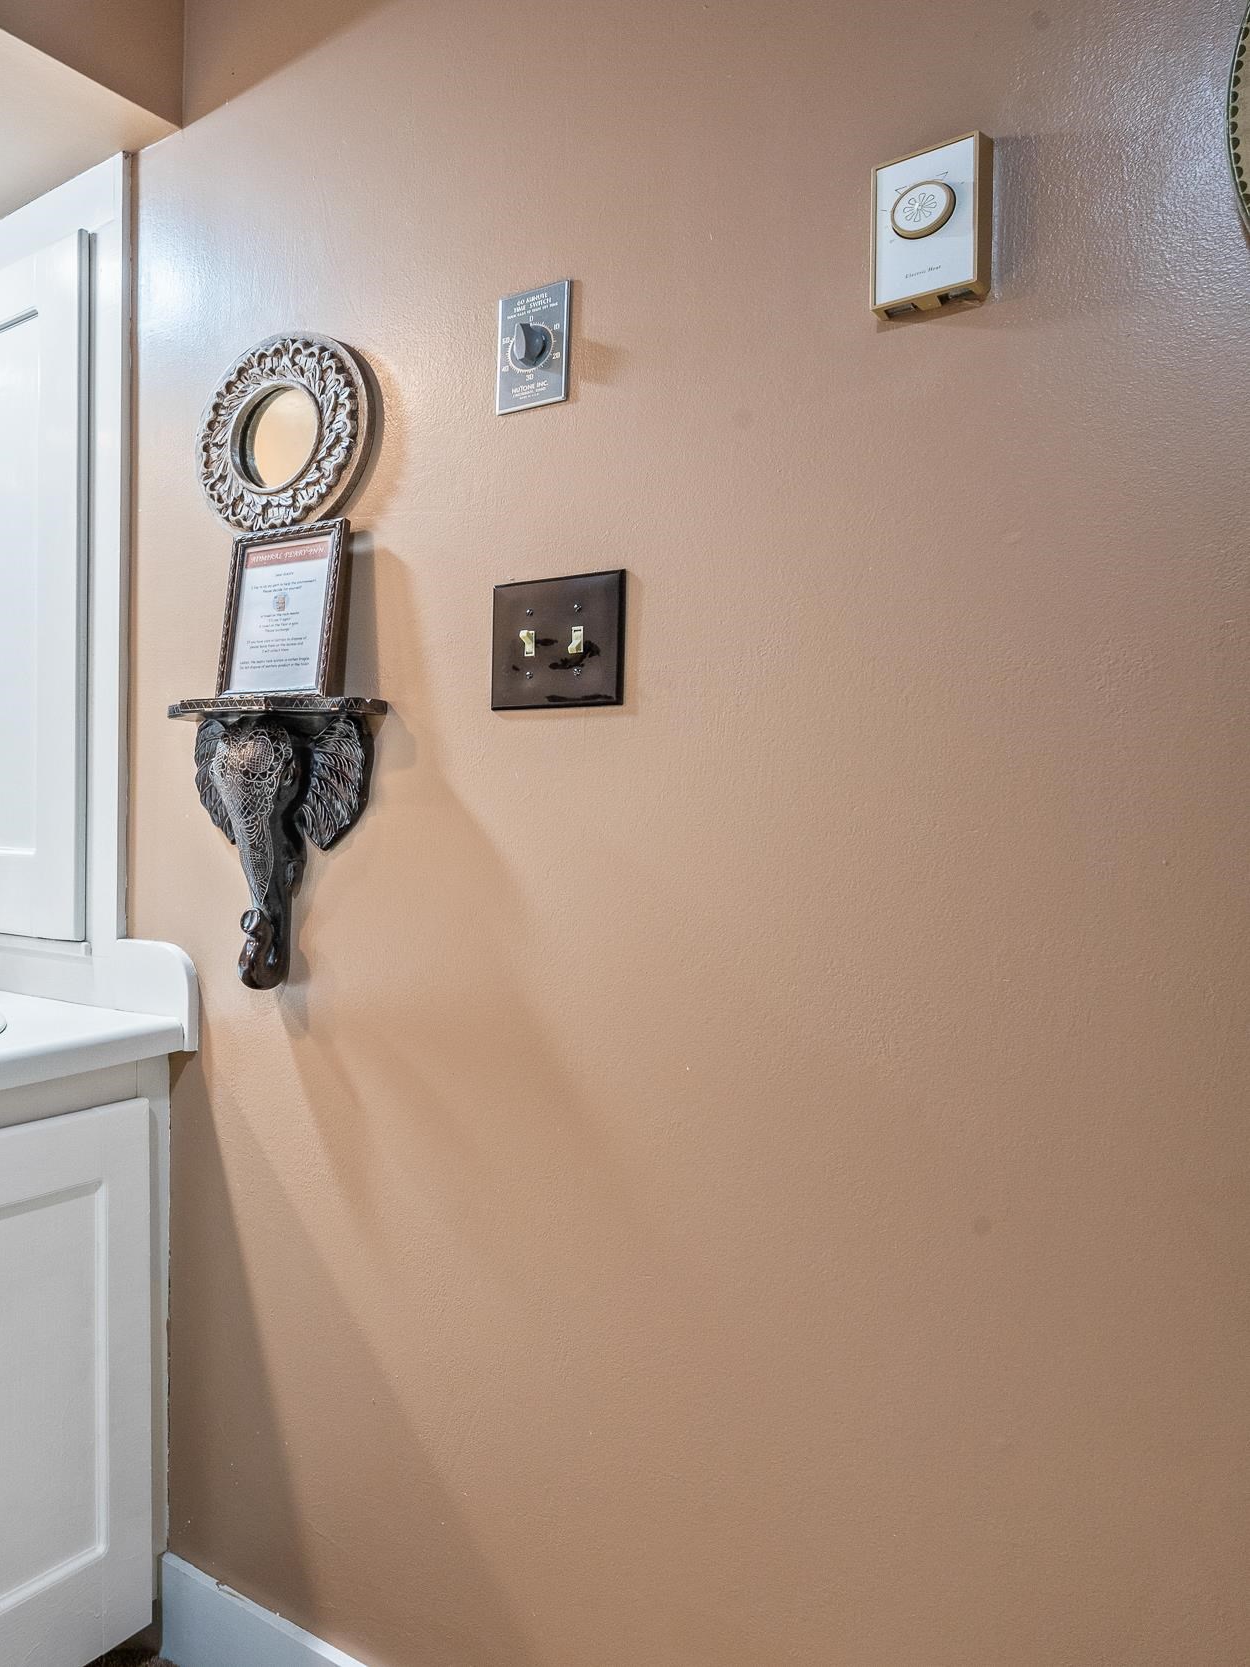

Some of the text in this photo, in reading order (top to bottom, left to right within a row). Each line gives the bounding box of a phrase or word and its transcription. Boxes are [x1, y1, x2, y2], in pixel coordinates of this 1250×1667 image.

[905, 264, 941, 279] Electric Heat
[526, 292, 548, 304] MINUTE
[514, 297, 552, 313] TIME SWITCH
[502, 336, 510, 344] 50
[552, 352, 560, 360] 20
[251, 552, 283, 563] ADMIRAL
[284, 548, 308, 558] PEARY
